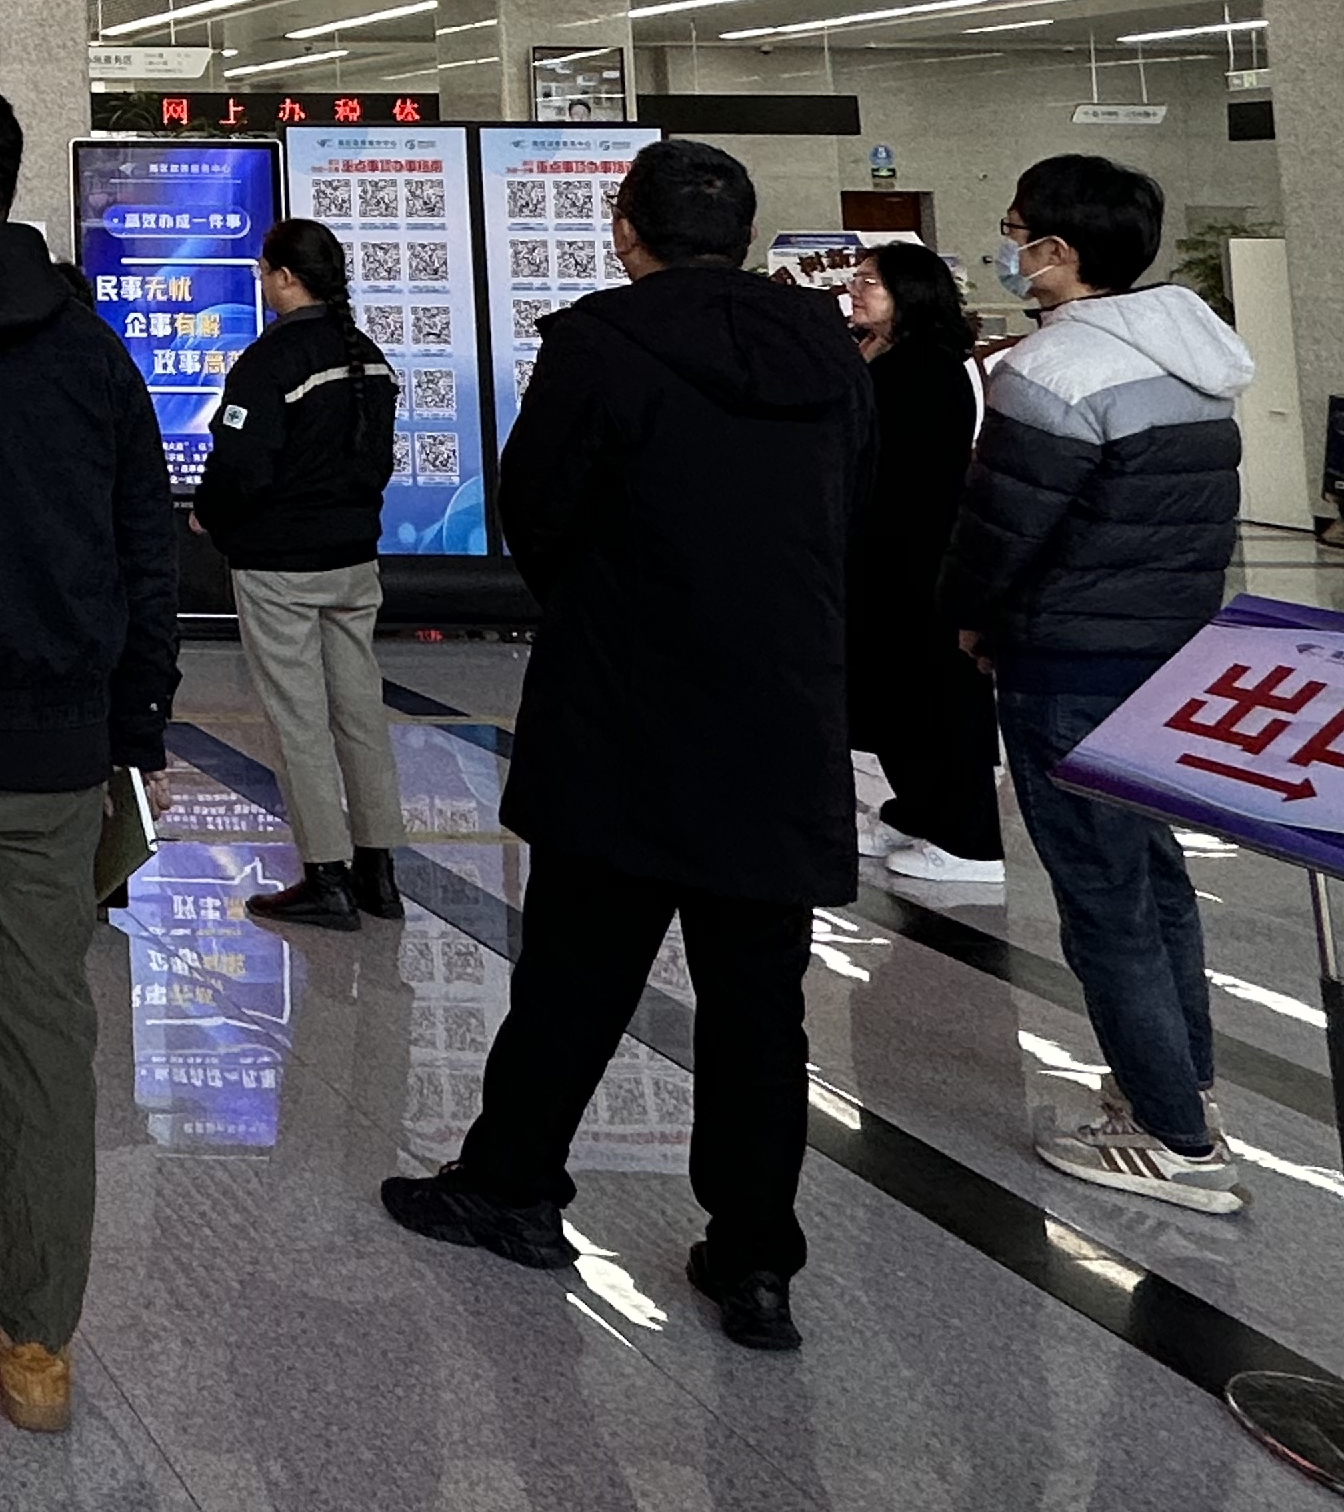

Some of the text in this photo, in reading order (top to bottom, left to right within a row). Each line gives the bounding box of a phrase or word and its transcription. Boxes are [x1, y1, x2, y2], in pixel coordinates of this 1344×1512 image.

[124, 212, 242, 229] 高效办成一件事
[96, 275, 193, 302] 民事无忧
[124, 312, 222, 338] 企事有解
